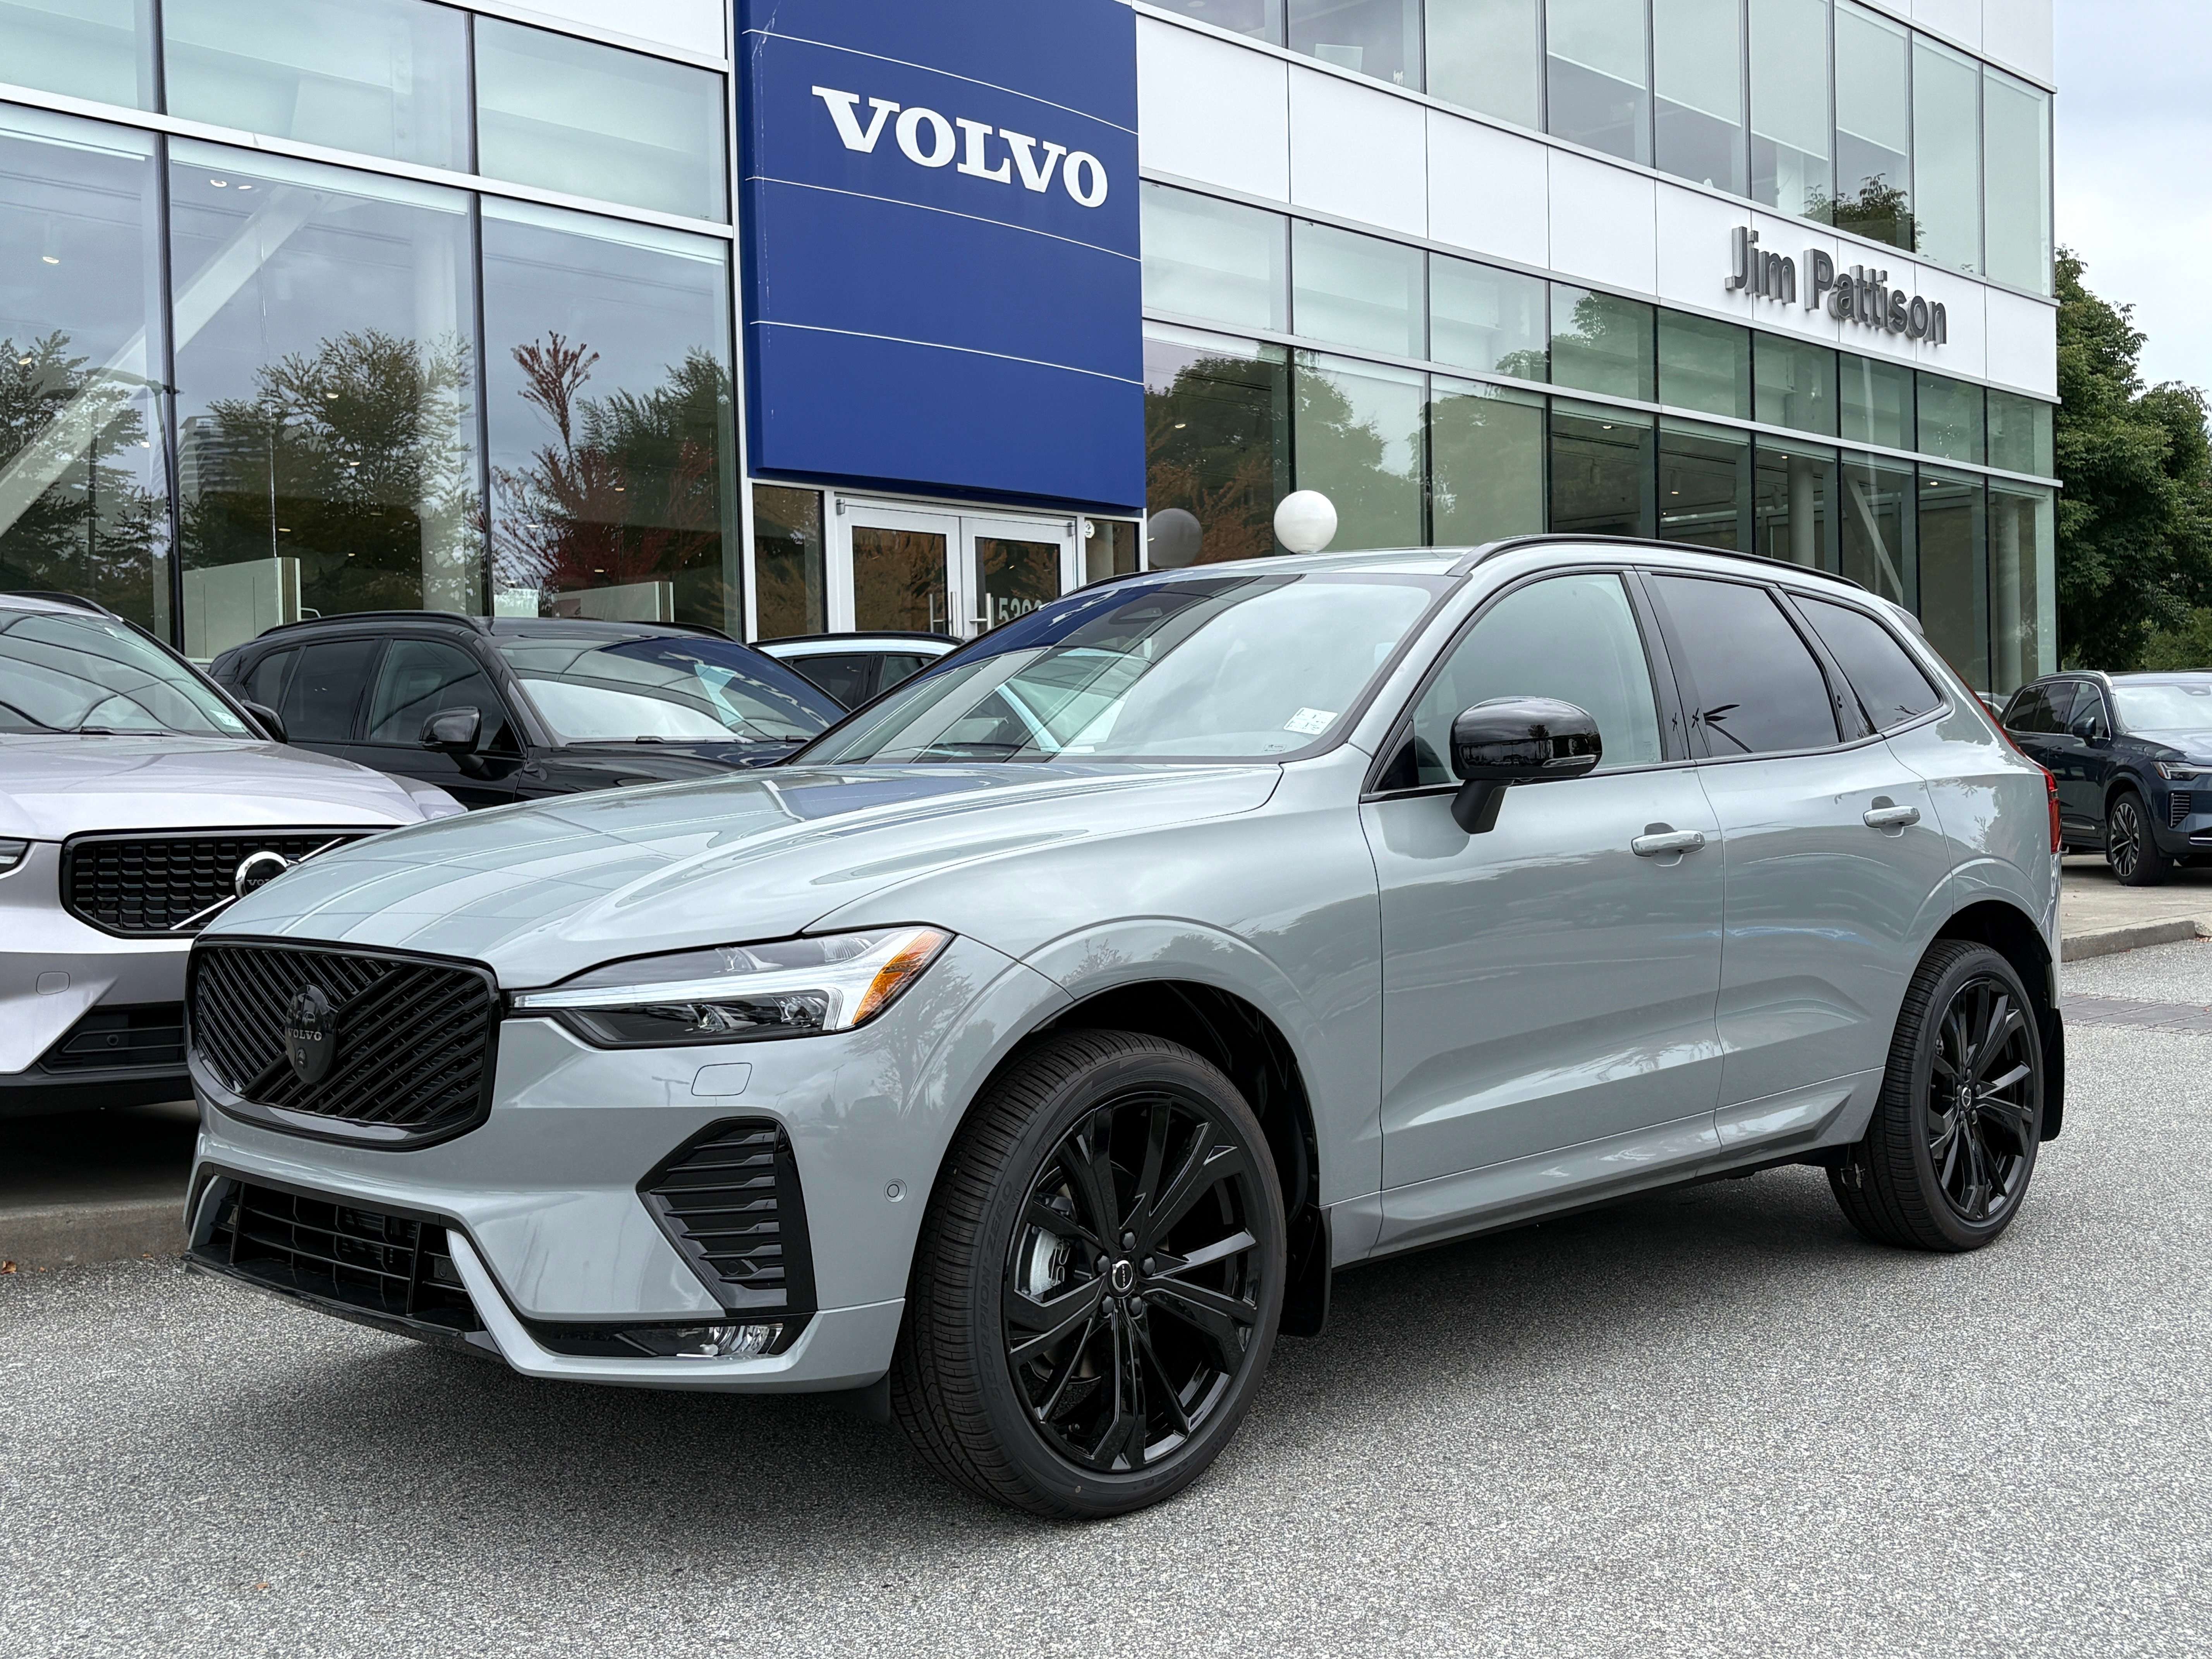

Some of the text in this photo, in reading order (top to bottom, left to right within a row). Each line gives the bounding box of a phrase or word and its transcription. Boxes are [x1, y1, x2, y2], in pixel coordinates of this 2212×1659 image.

[812, 86, 1108, 208] VOLVO
[1724, 226, 1947, 345] Jim Pattison
[288, 1027, 322, 1041] VOLVO
